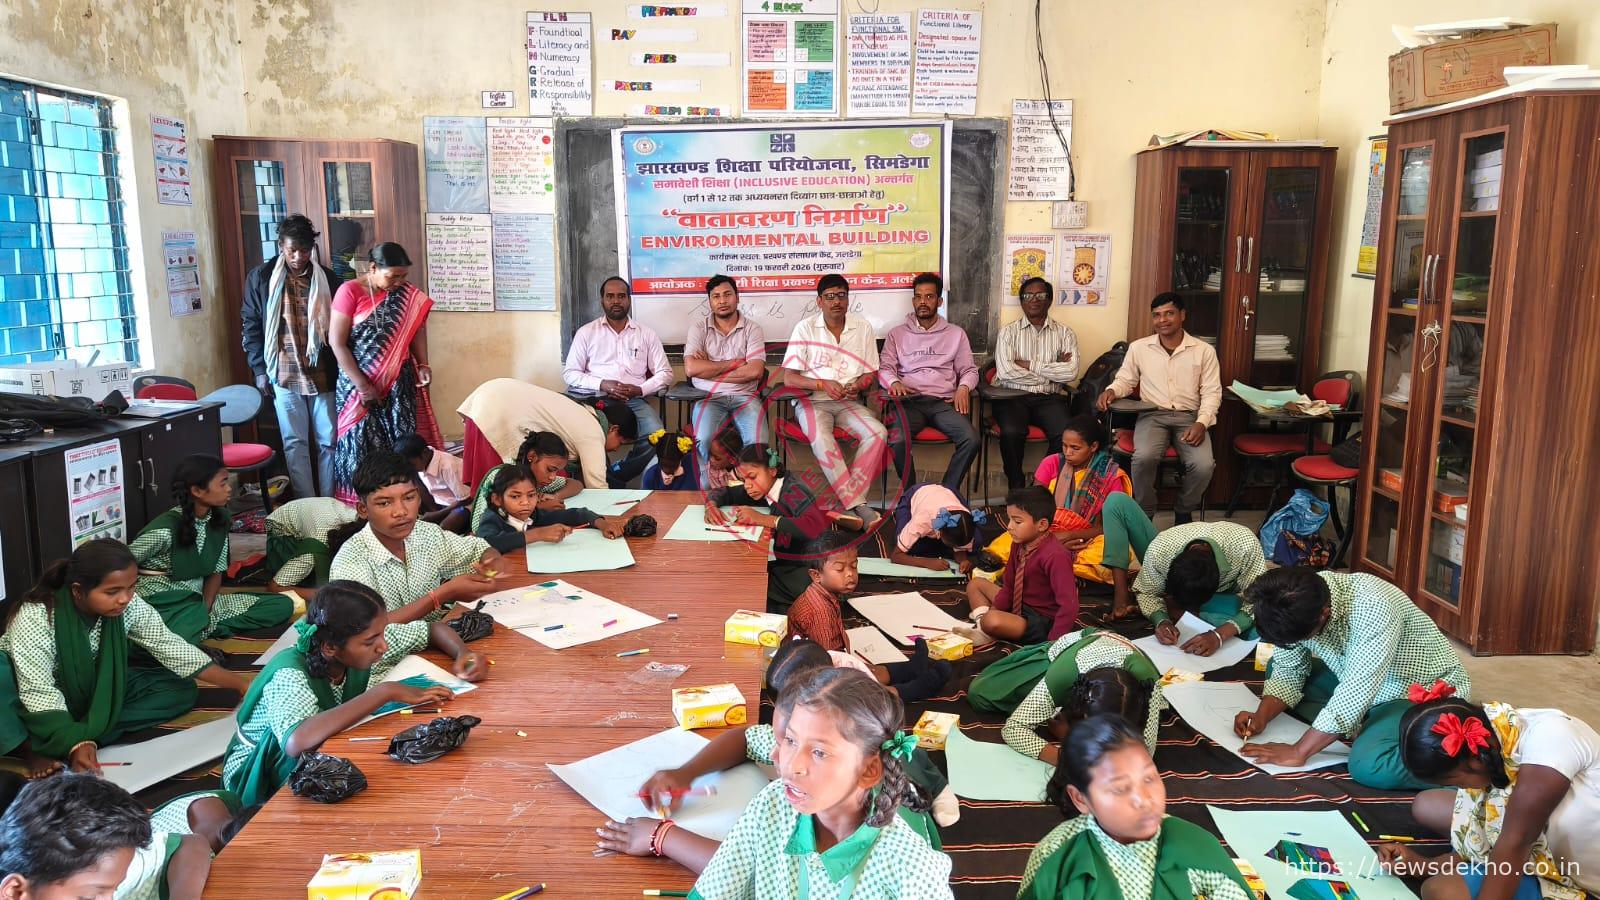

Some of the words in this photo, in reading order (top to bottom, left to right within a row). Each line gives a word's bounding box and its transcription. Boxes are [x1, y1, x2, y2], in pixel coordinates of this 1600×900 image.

[923, 12, 958, 20] CRITERIA
[612, 29, 636, 40] PLAY
[539, 40, 572, 51] Literacy
[574, 40, 589, 50] and
[540, 53, 580, 63] Numeracy
[540, 66, 574, 76] Gradual
[540, 78, 574, 87] Release
[577, 79, 585, 87] of
[540, 90, 591, 100] Responsibility
[636, 161, 711, 175] झारखण्ड
[716, 158, 762, 174] शिक्षा
[768, 155, 857, 173] परियोजना,
[864, 154, 931, 170] सिमडेगा
[653, 176, 700, 190] समावेशी
[701, 176, 731, 188] शिक्षा
[734, 176, 798, 189] (INCLUSIVE
[802, 175, 871, 187] EDUCATION)
[875, 174, 914, 185] अन्तर्गत
[707, 193, 716, 202] से
[718, 194, 727, 202] 12
[729, 194, 742, 202] तक
[641, 232, 823, 249] ENVIRONMENTAL
[828, 229, 931, 245] BUILDING
[765, 262, 789, 272] फरवरी
[791, 264, 811, 272] 2026
[751, 275, 779, 288] शिक्षा
[782, 278, 816, 287] प्रखण्ड
[767, 301, 785, 319] is
